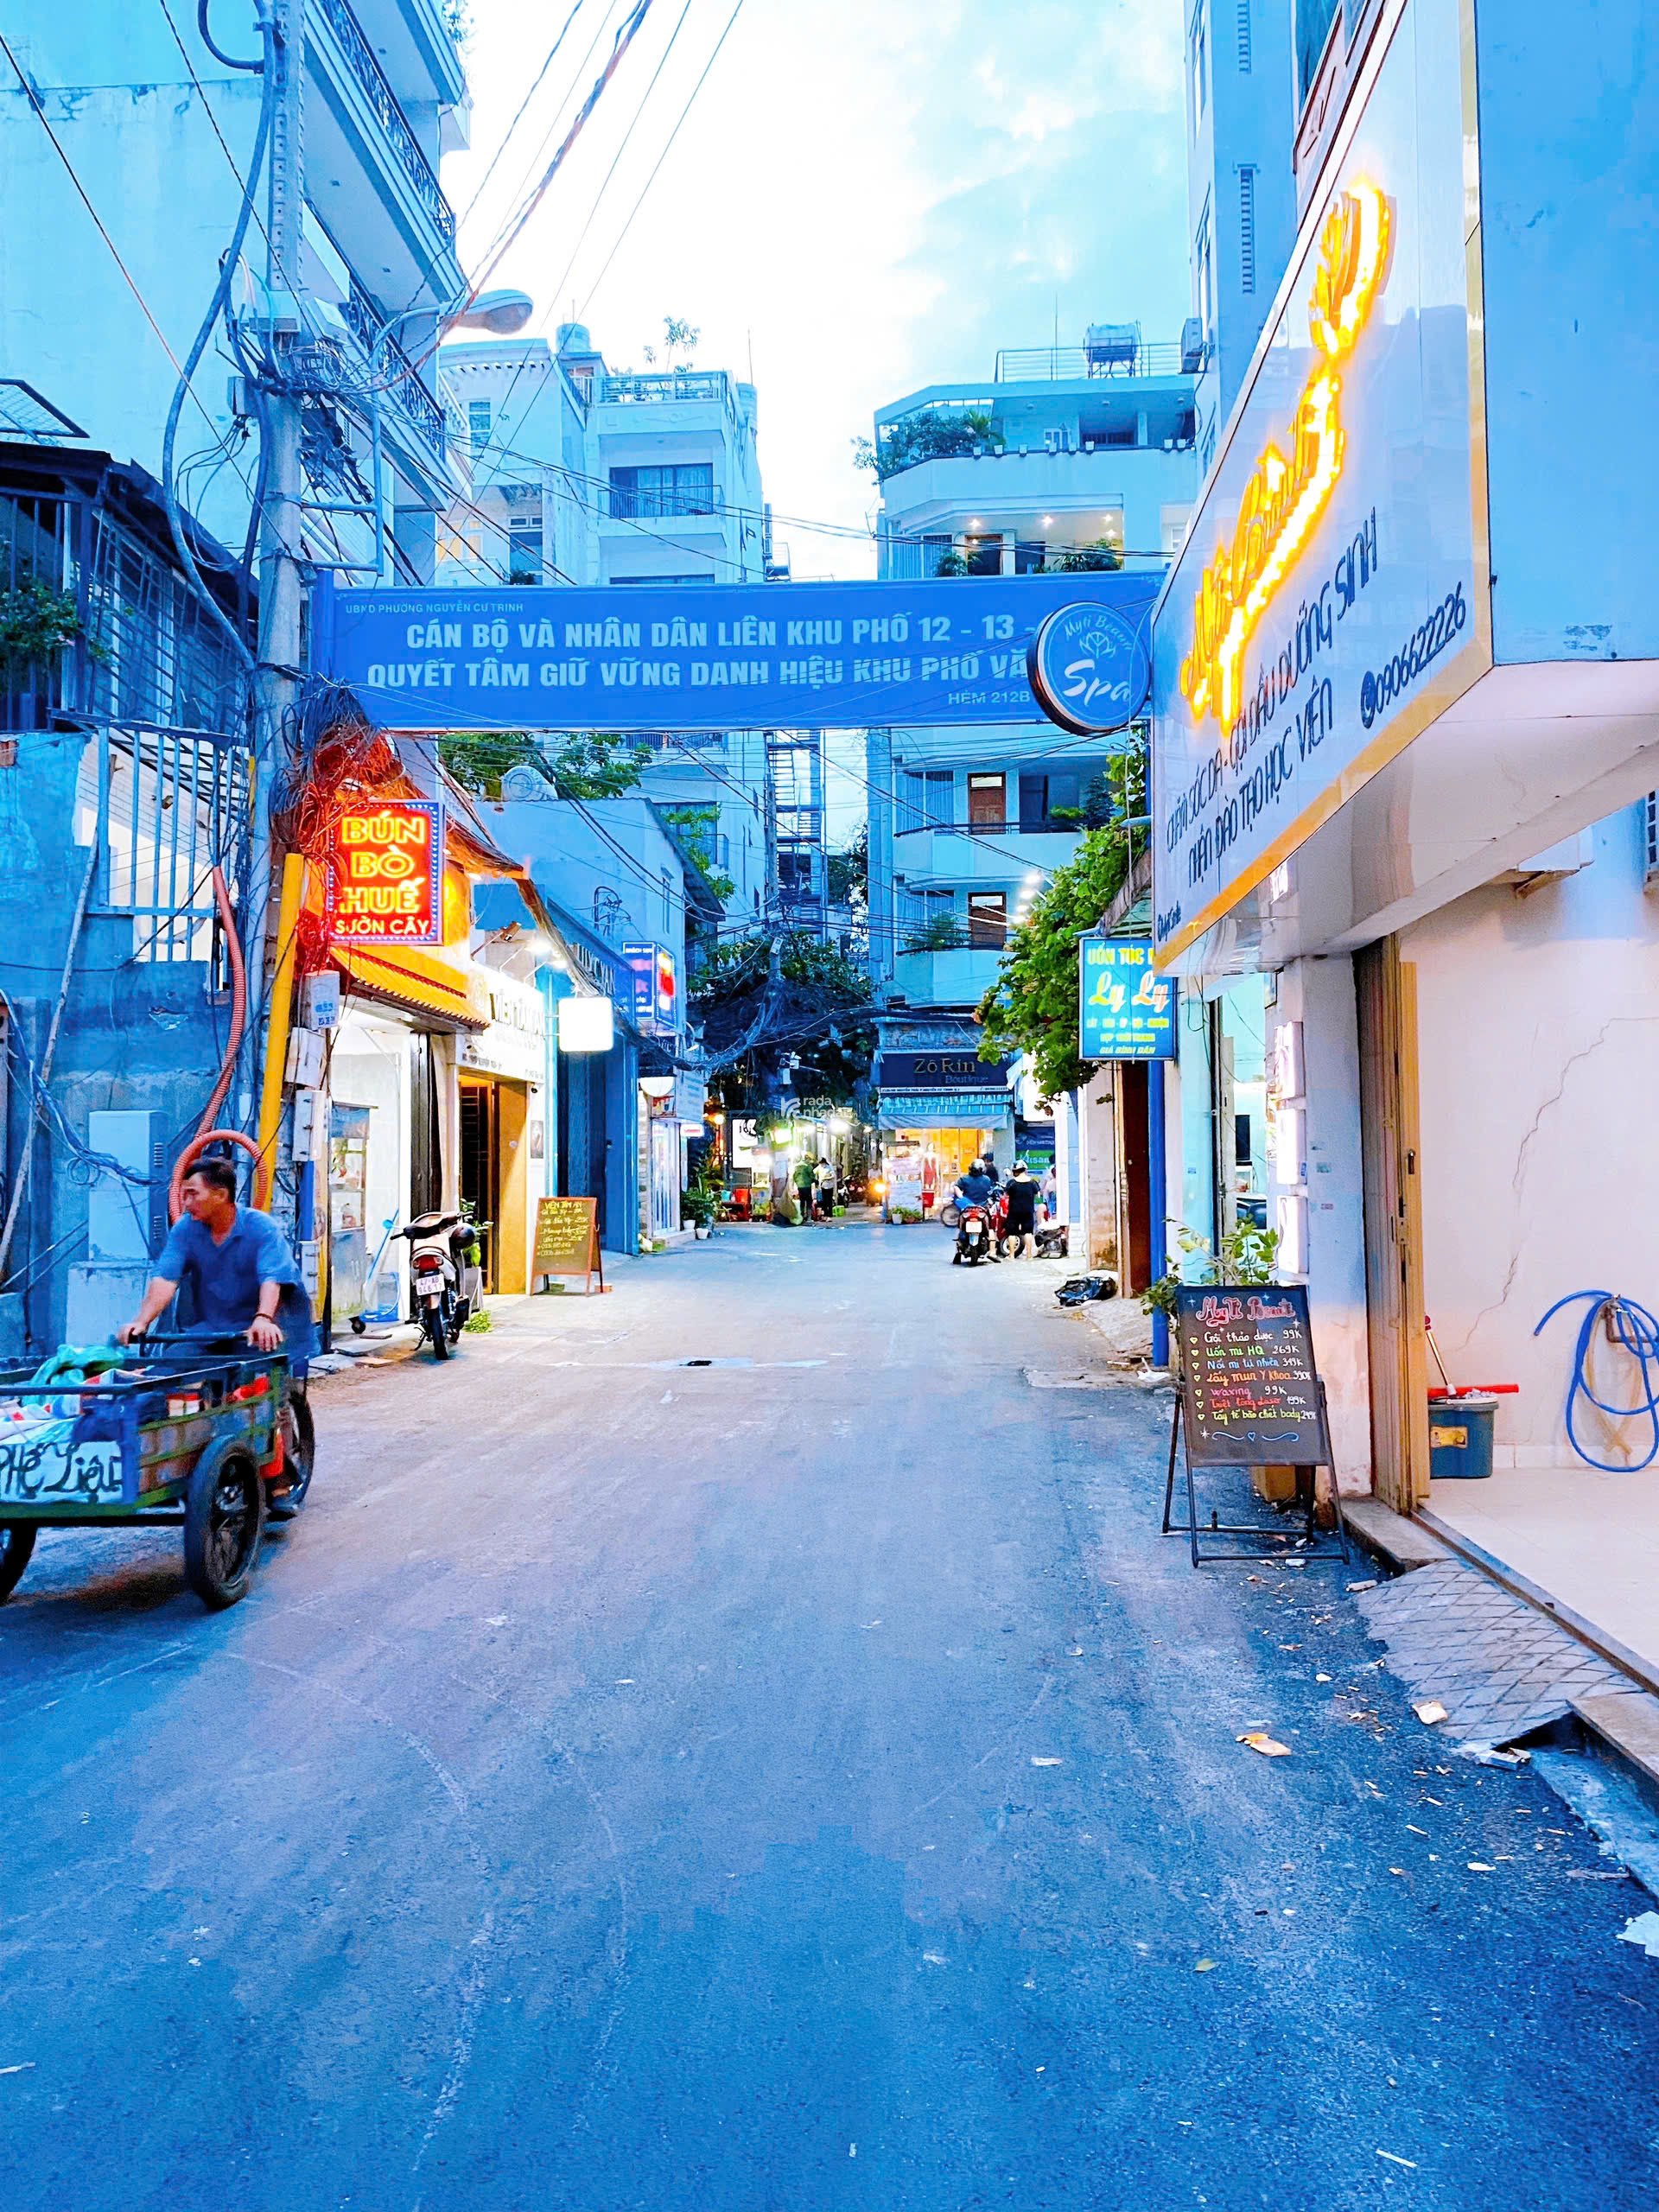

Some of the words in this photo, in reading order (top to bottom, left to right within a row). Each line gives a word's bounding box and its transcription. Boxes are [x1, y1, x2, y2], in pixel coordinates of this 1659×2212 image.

[346, 603, 376, 613] UBND
[407, 617, 465, 649] CÁN
[473, 617, 508, 654] BỘ
[518, 617, 556, 648] VÀ
[566, 615, 642, 648] NHÂN
[652, 615, 707, 647] DÂN
[718, 614, 776, 646] LIÊN
[787, 620, 842, 646] KHU
[853, 611, 913, 645] PHỐ
[918, 616, 950, 642] 12
[982, 613, 1015, 640] 13
[368, 658, 455, 689] QUYẾT
[466, 657, 529, 688] TÂM
[540, 657, 589, 687] GIỮ
[600, 657, 680, 687] VỮNG
[690, 661, 769, 687] DANH
[779, 655, 843, 690] HIỆU
[855, 658, 911, 683] KHU
[922, 649, 984, 682] PHỐ
[1189, 764, 1207, 824] SÓC
[1209, 747, 1224, 800] DA
[1335, 506, 1376, 620] SINH
[994, 690, 1031, 703] 212B
[1063, 659, 1130, 707] Spa
[1216, 795, 1238, 859] ĐÀO
[1239, 766, 1263, 832] TẠO
[1265, 726, 1293, 804] HỌC
[1296, 675, 1332, 762] VIÊN
[341, 810, 426, 844] BÚN
[351, 844, 415, 879] BÒ
[339, 877, 426, 914] HUẾ
[1088, 970, 1127, 1014] Ly
[1131, 969, 1170, 1014] Ly
[945, 1075, 989, 1084] Boutique
[1204, 1331, 1222, 1344] Gội
[1226, 1331, 1249, 1342] thảo
[1282, 1328, 1302, 1339] 99K
[1205, 1345, 1226, 1357] Uốn
[1247, 1345, 1264, 1356] HQ
[1272, 1344, 1300, 1355] 269K
[1207, 1358, 1225, 1370] Nối
[1264, 1385, 1287, 1395] 99K
[1280, 1408, 1300, 1422] body
